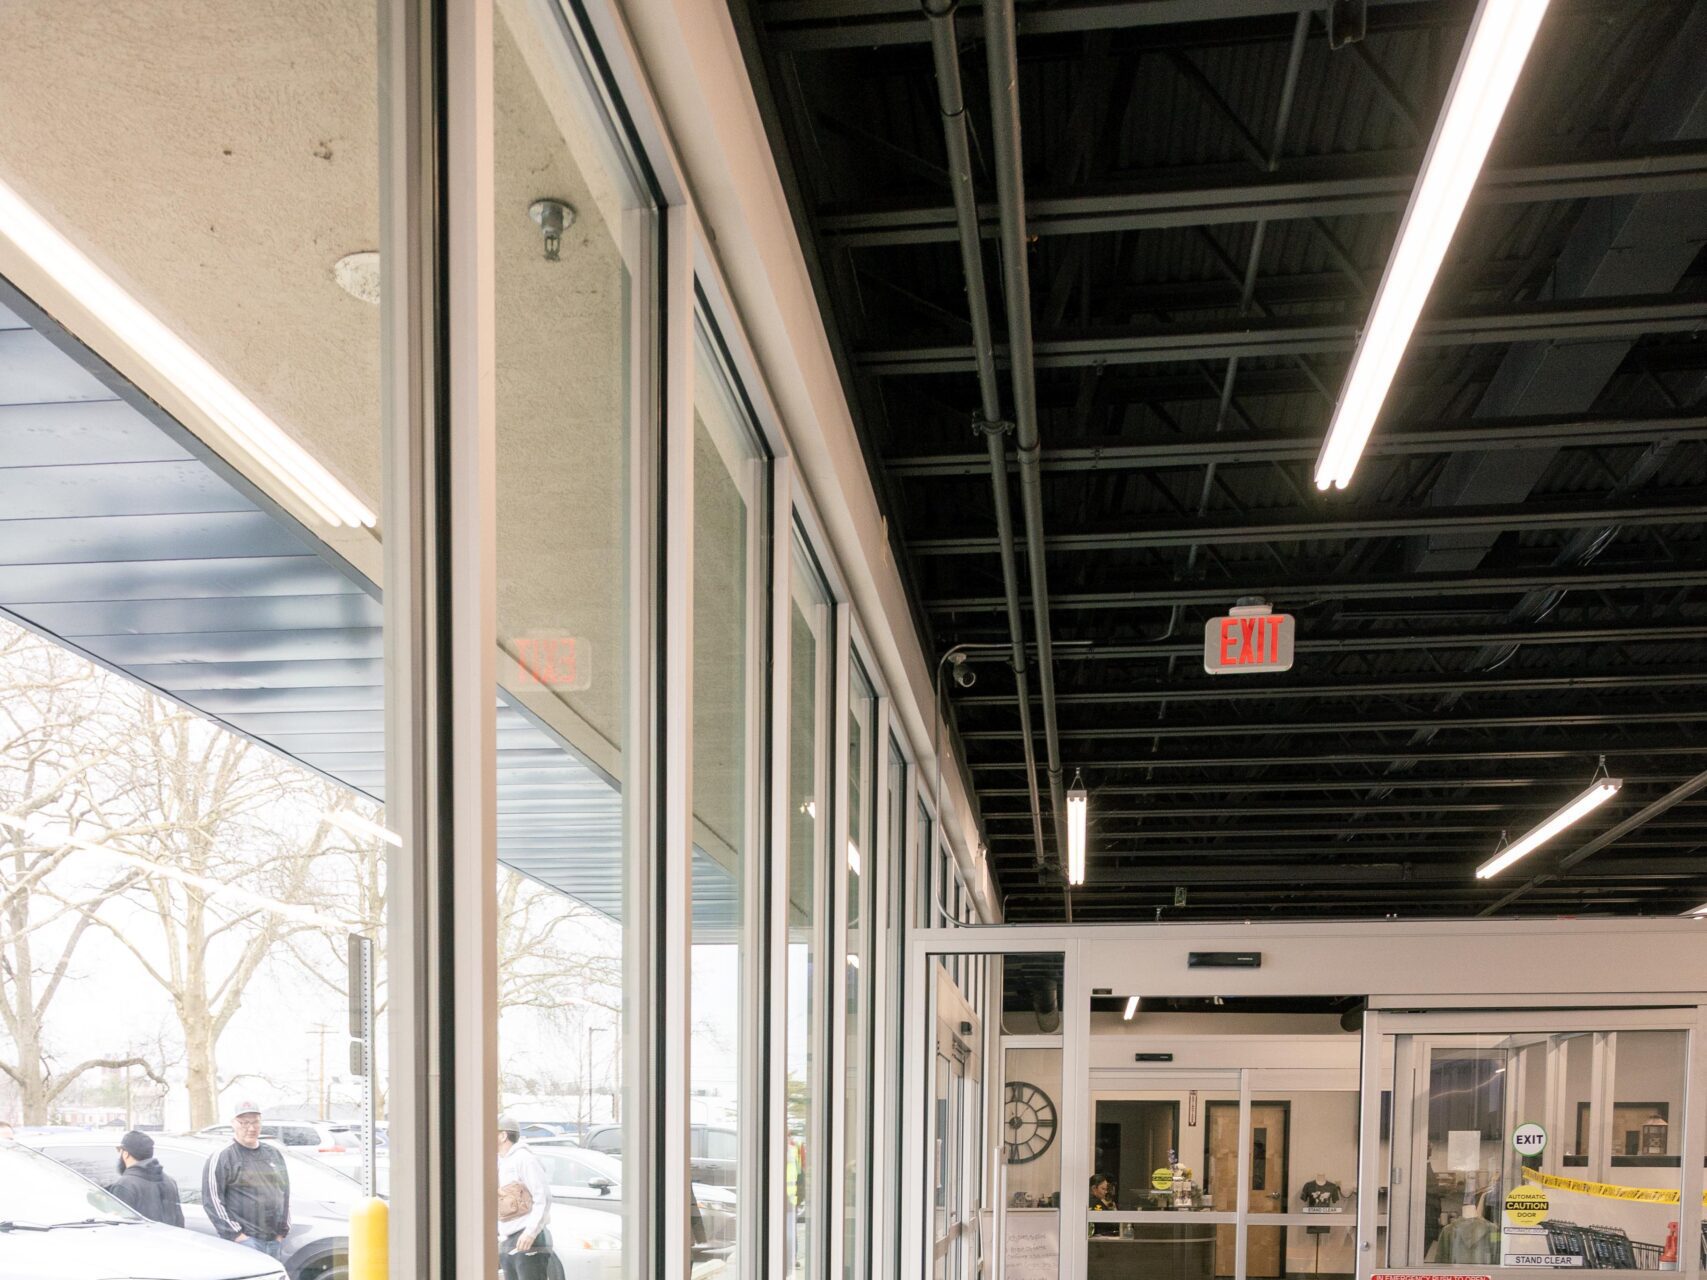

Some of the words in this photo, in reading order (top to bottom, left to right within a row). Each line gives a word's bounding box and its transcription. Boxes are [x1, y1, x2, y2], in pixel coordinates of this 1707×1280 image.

[1220, 615, 1284, 665] EXIT
[1516, 1134, 1544, 1145] EXIT
[1506, 1202, 1548, 1210] CAUTION
[1515, 1256, 1543, 1264] STAND
[1544, 1256, 1572, 1265] CLEAR
